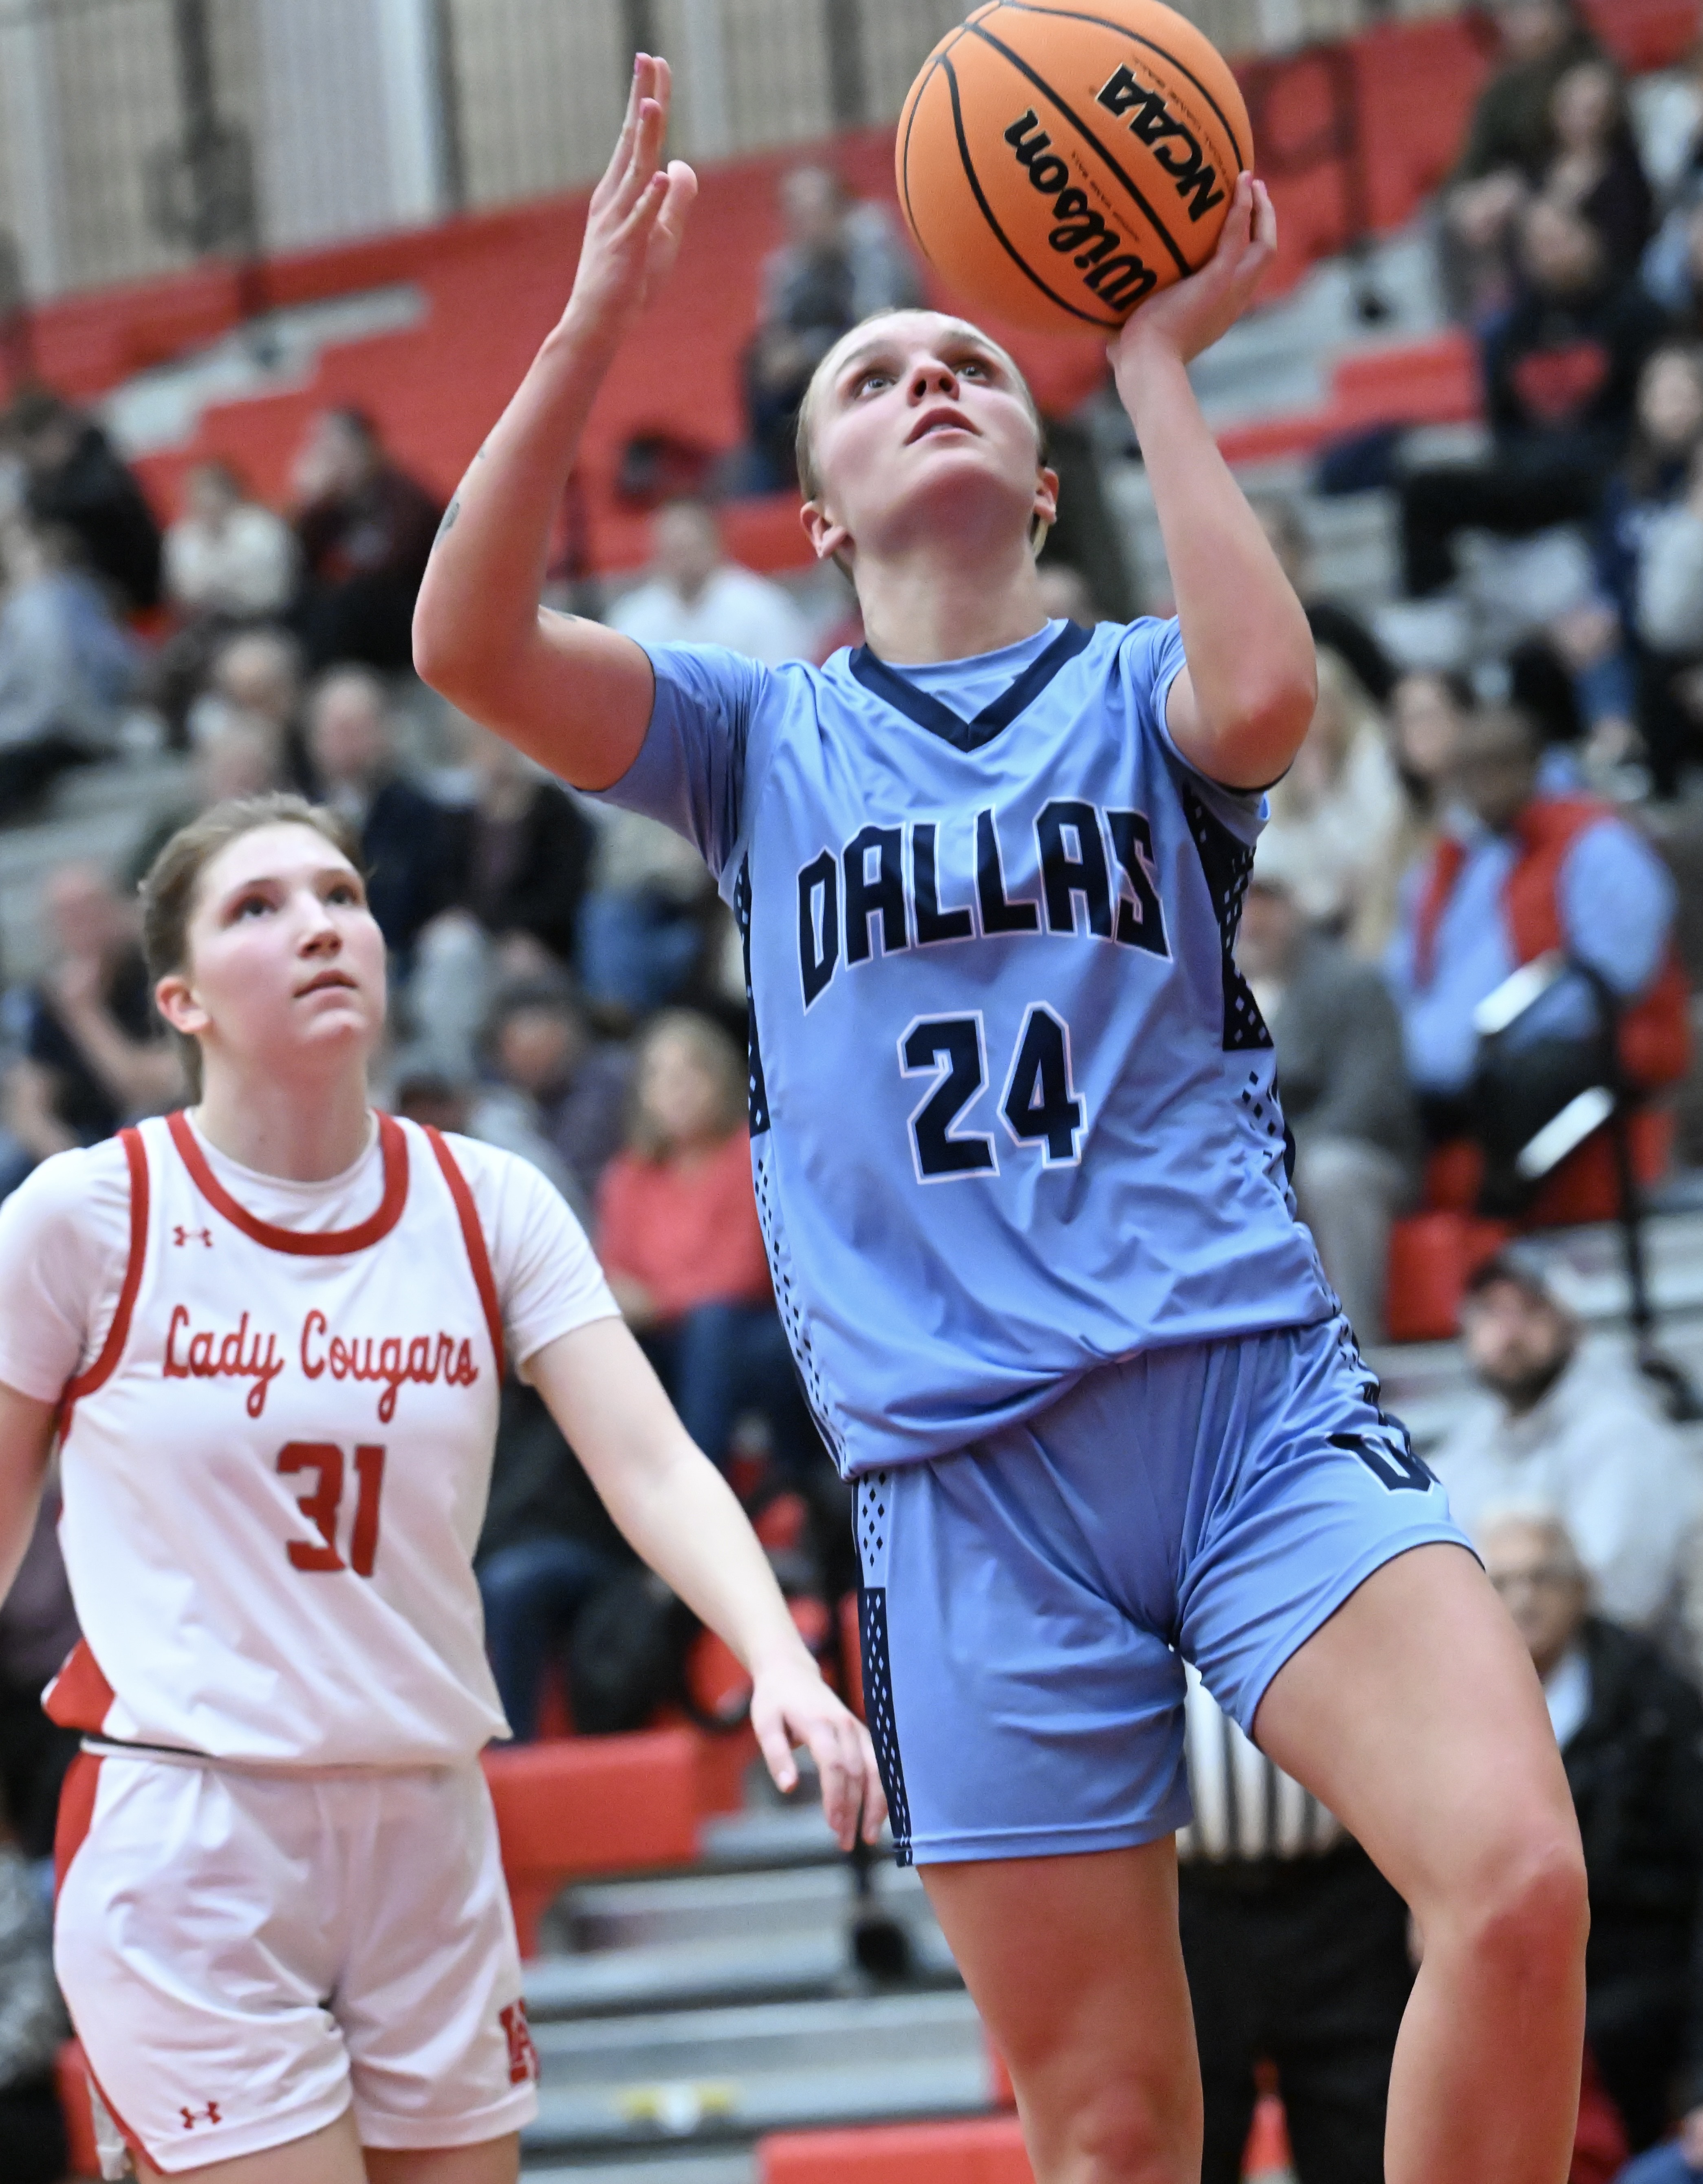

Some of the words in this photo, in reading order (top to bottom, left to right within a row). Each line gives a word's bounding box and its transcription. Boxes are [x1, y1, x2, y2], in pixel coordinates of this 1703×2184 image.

[1003, 108, 1158, 313] Wilson
[1095, 62, 1225, 223] NCAA
[797, 796, 1174, 1017] DALLAS
[896, 1000, 1088, 1185] 24
[163, 1304, 285, 1418] Lady
[300, 1308, 479, 1424] Cougars
[275, 1441, 386, 1578] 31
